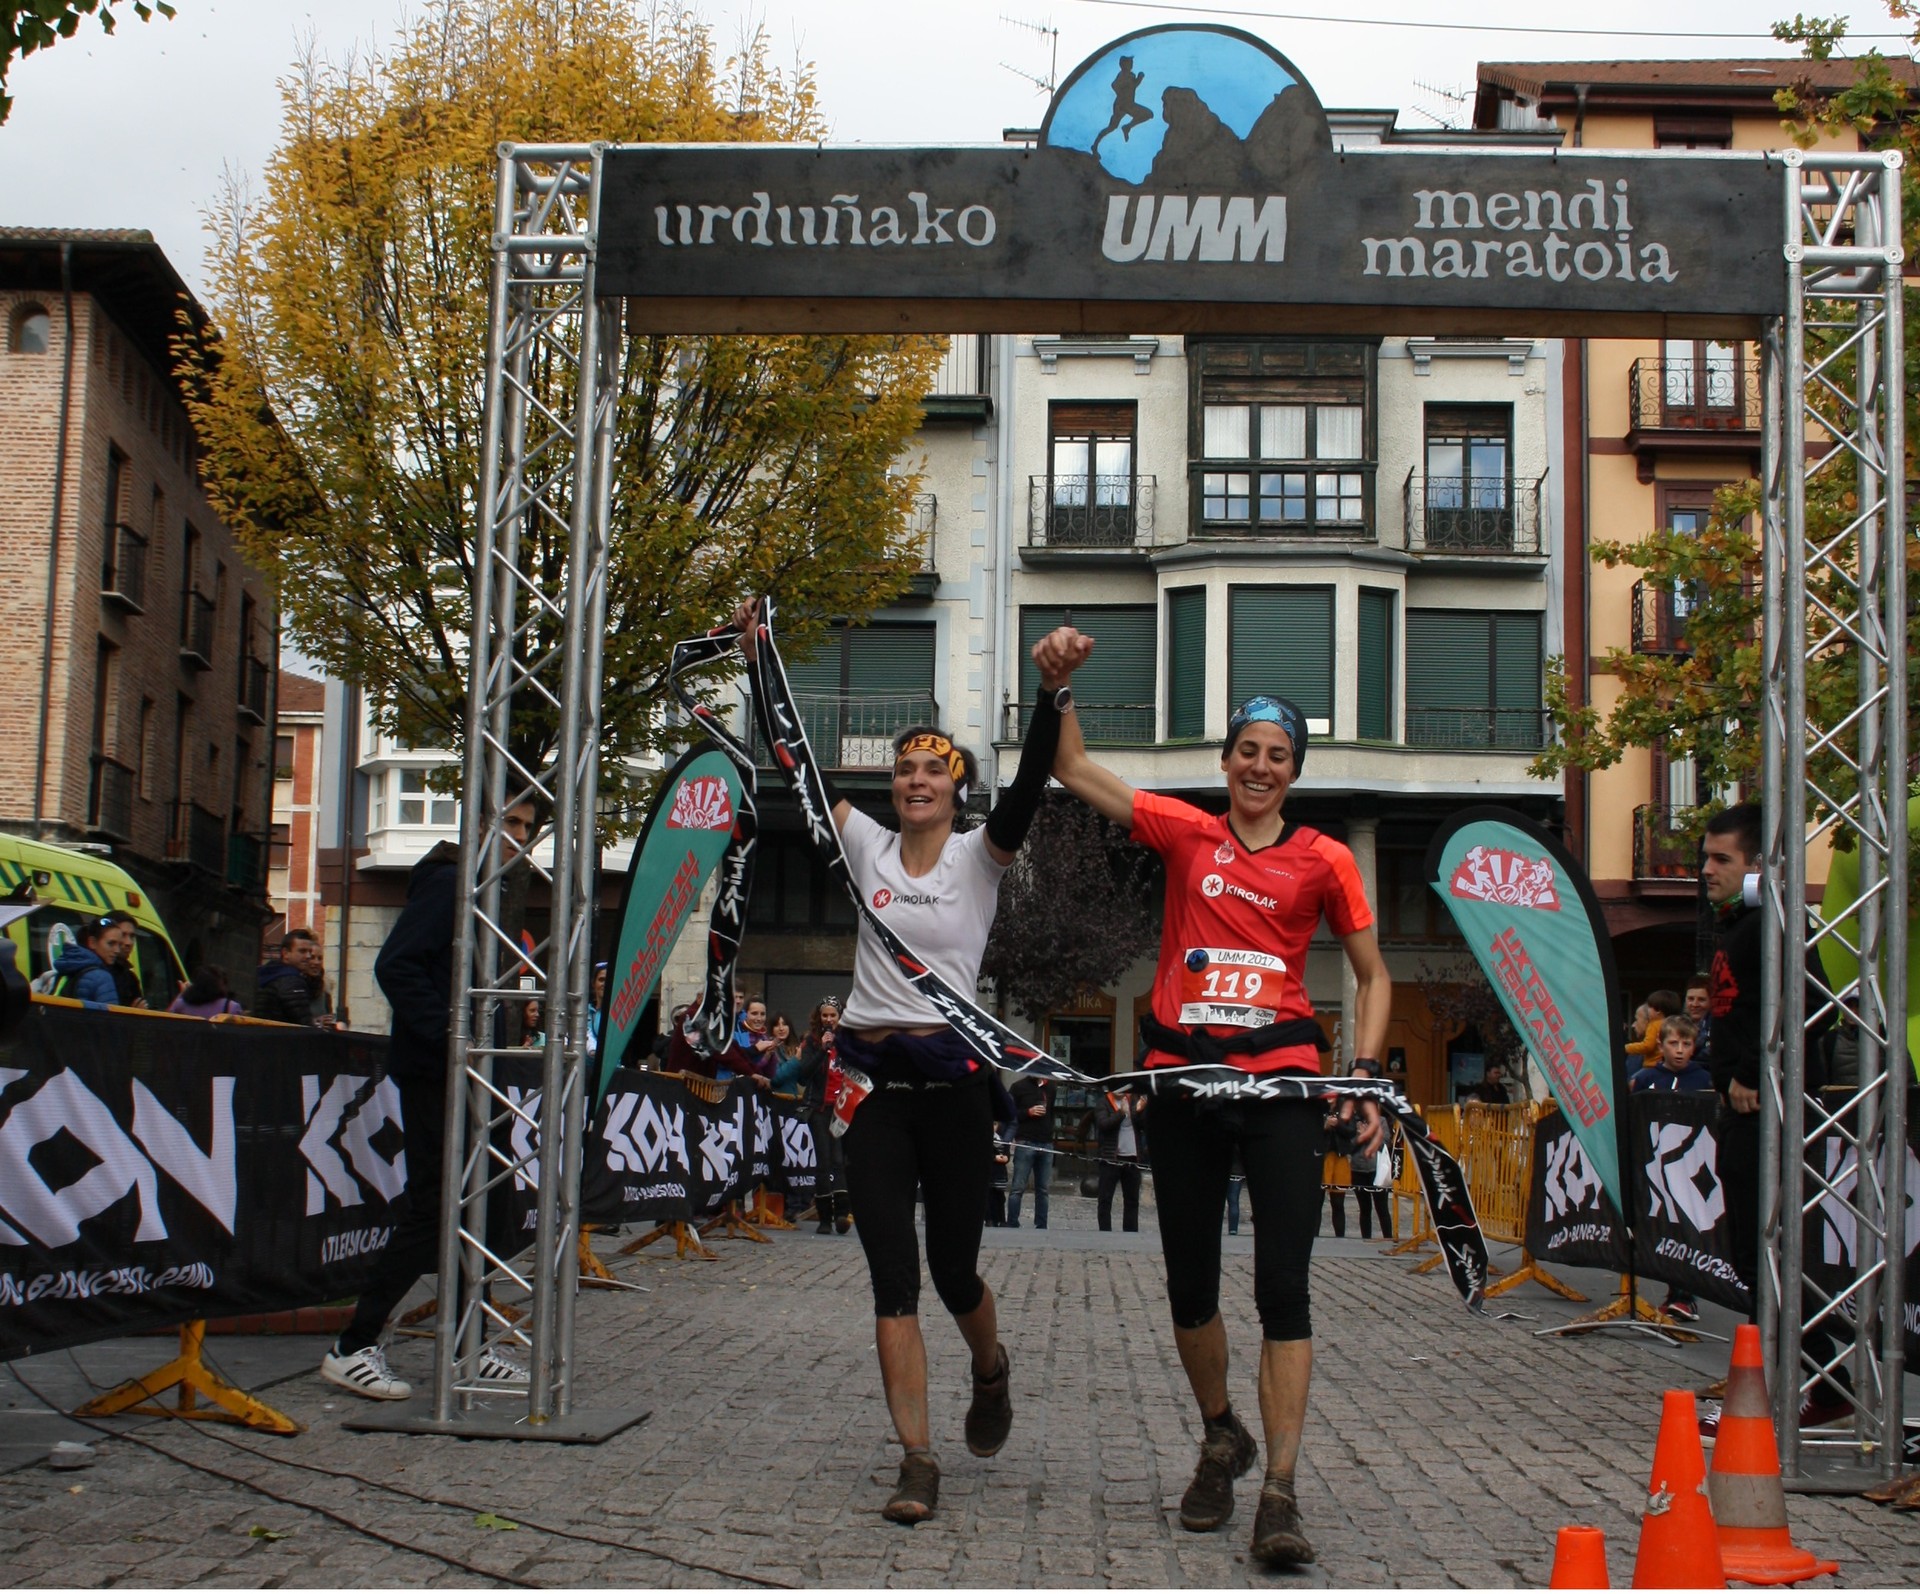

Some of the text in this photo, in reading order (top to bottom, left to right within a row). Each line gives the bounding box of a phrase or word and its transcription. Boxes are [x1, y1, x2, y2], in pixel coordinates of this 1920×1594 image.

[653, 191, 997, 247] urduñako
[1412, 178, 1635, 232] mendi
[1101, 194, 1288, 263] UMM
[1360, 228, 1680, 283] maratoia
[892, 894, 940, 906] KIROLAK
[1225, 883, 1278, 910] KIROLAK
[1217, 951, 1276, 967] UMM 2017
[1201, 970, 1262, 999] 119
[1178, 1074, 1283, 1100] Spiuk
